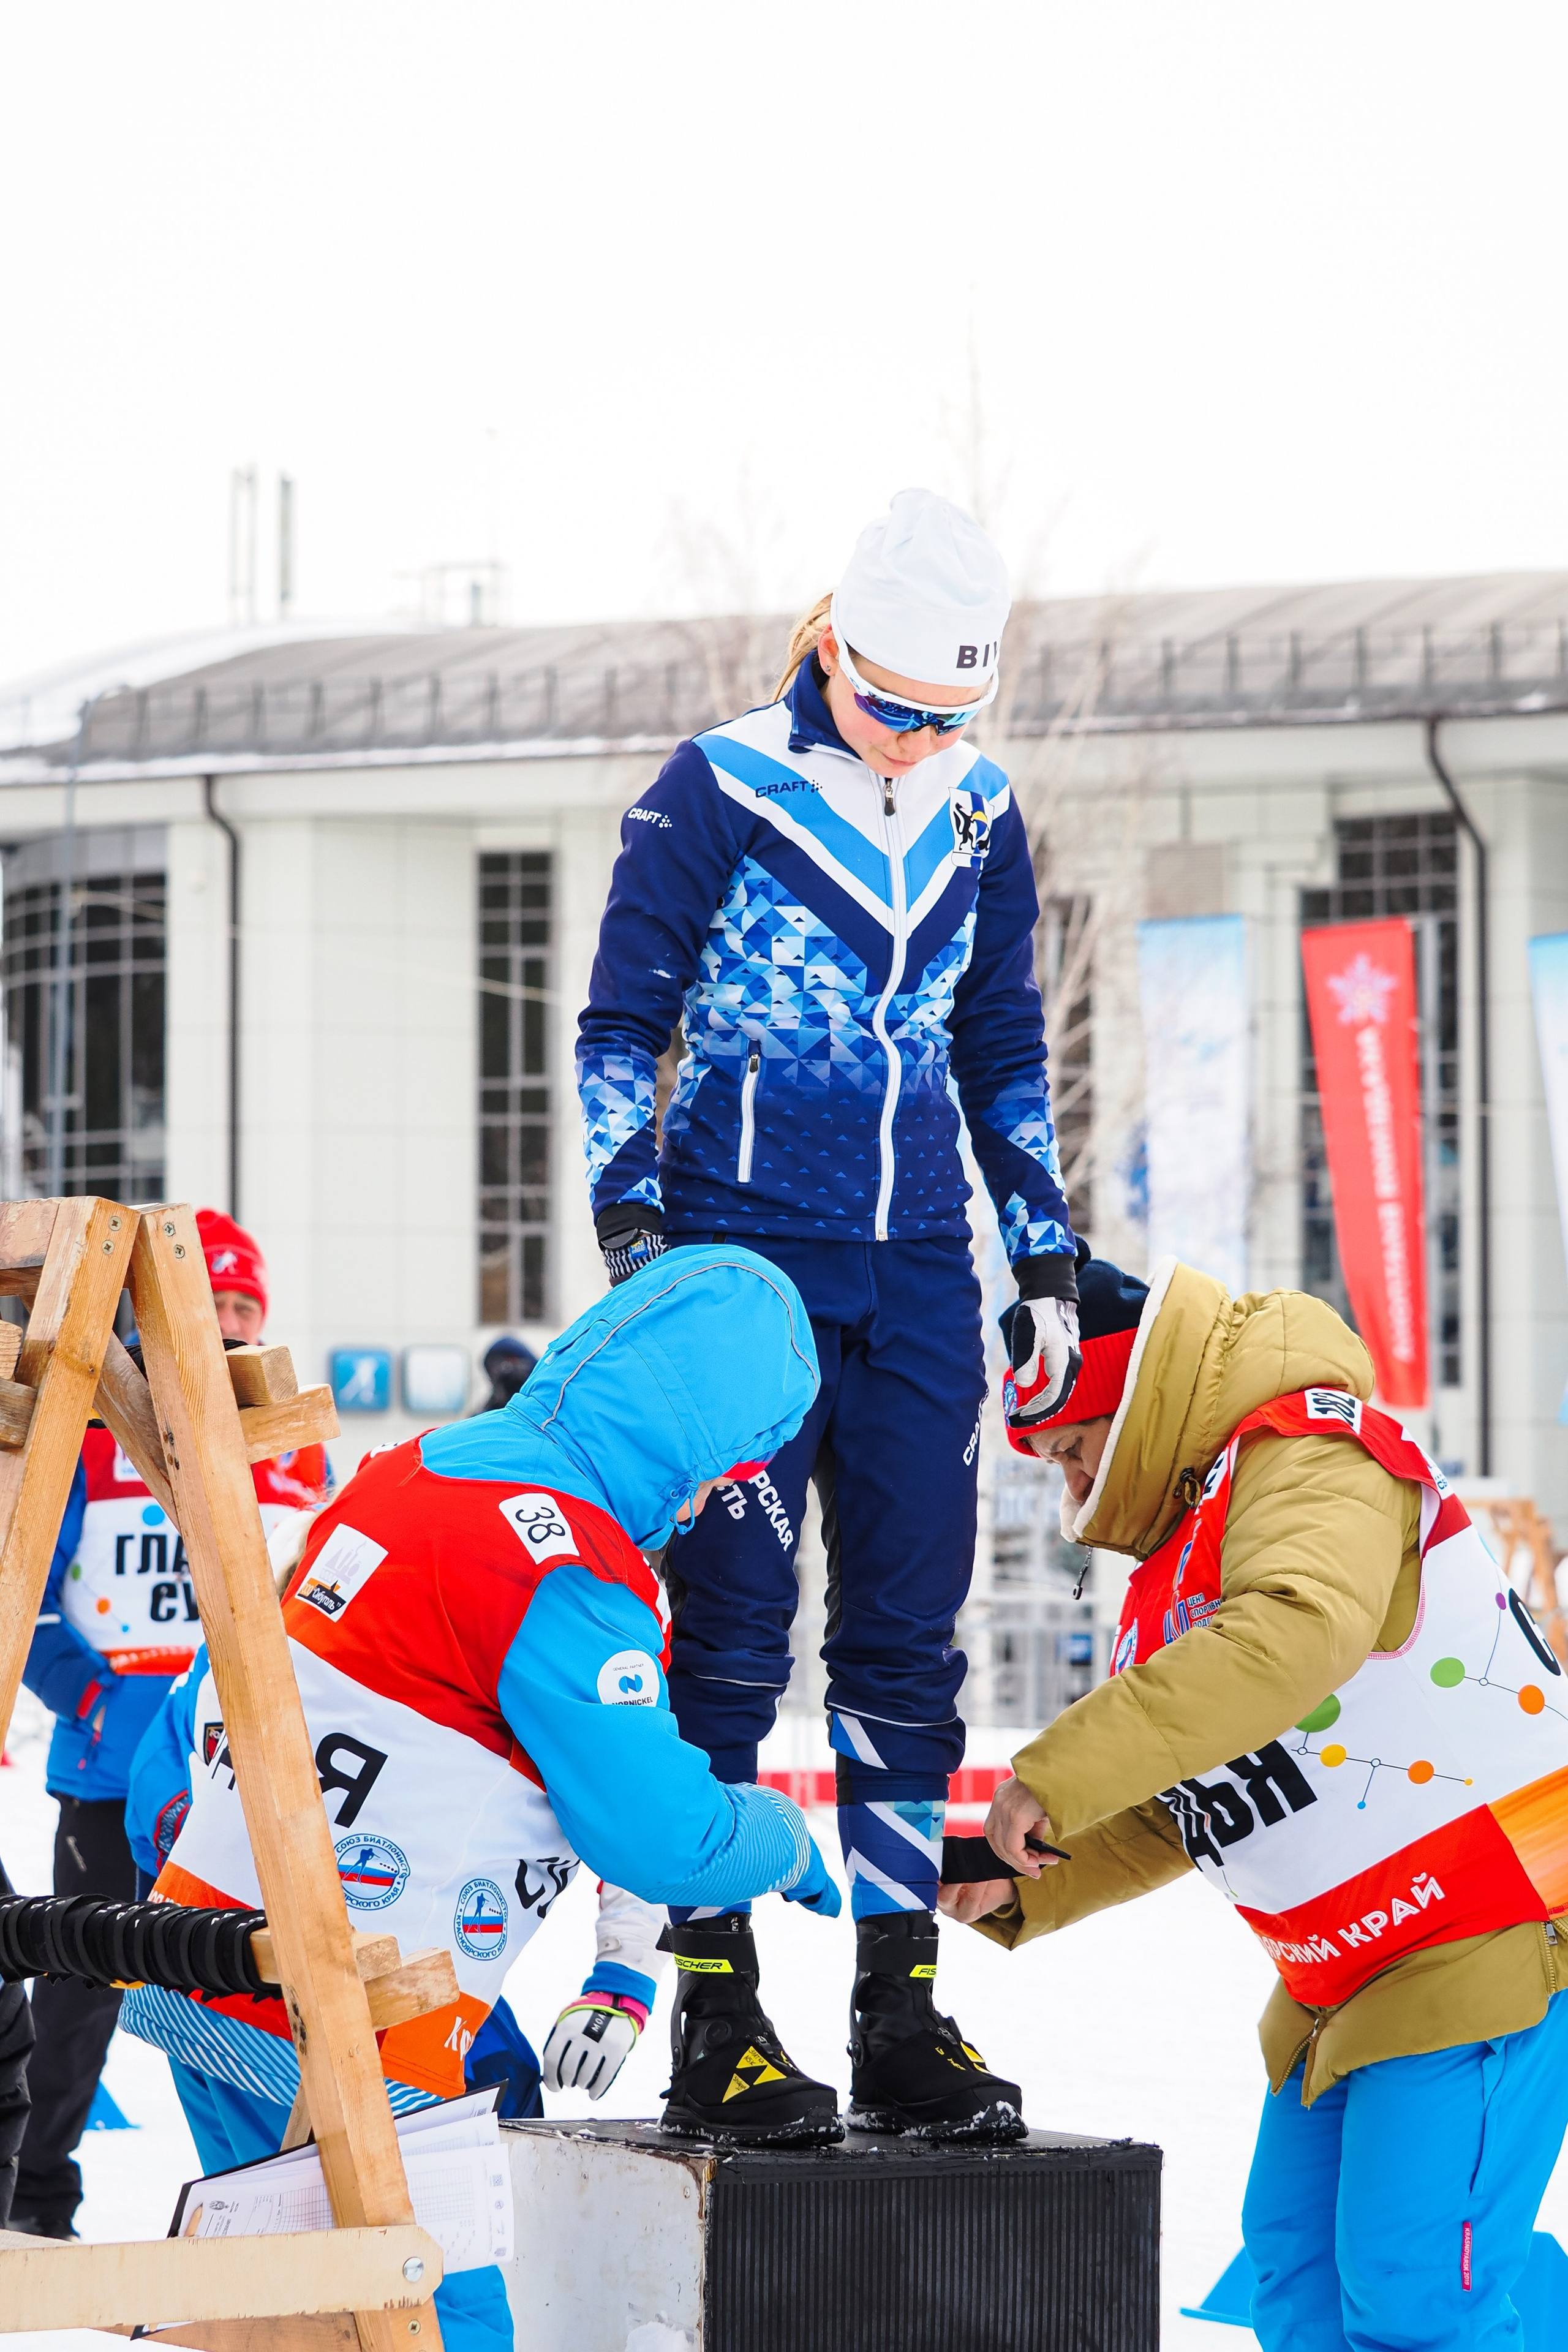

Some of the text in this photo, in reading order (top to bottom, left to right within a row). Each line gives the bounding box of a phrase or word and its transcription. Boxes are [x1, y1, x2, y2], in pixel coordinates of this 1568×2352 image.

[756, 781, 809, 797] CRAFT
[628, 807, 662, 824] CRAFT
[1311, 1392, 1355, 1427] 182
[717, 1482, 748, 1520] ТЬ
[515, 1506, 566, 1544] 38
[336, 1837, 361, 1853] СОЮЗ
[382, 1887, 399, 1905] КРАЯ
[461, 1885, 473, 1905] СОЮЗ
[1259, 1872, 1446, 1964] ЯРСКИЙ КРАЙ
[456, 1915, 506, 1958] КРАСНОЯРСКОГО КРАЯ
[674, 1956, 723, 1970] SCHER
